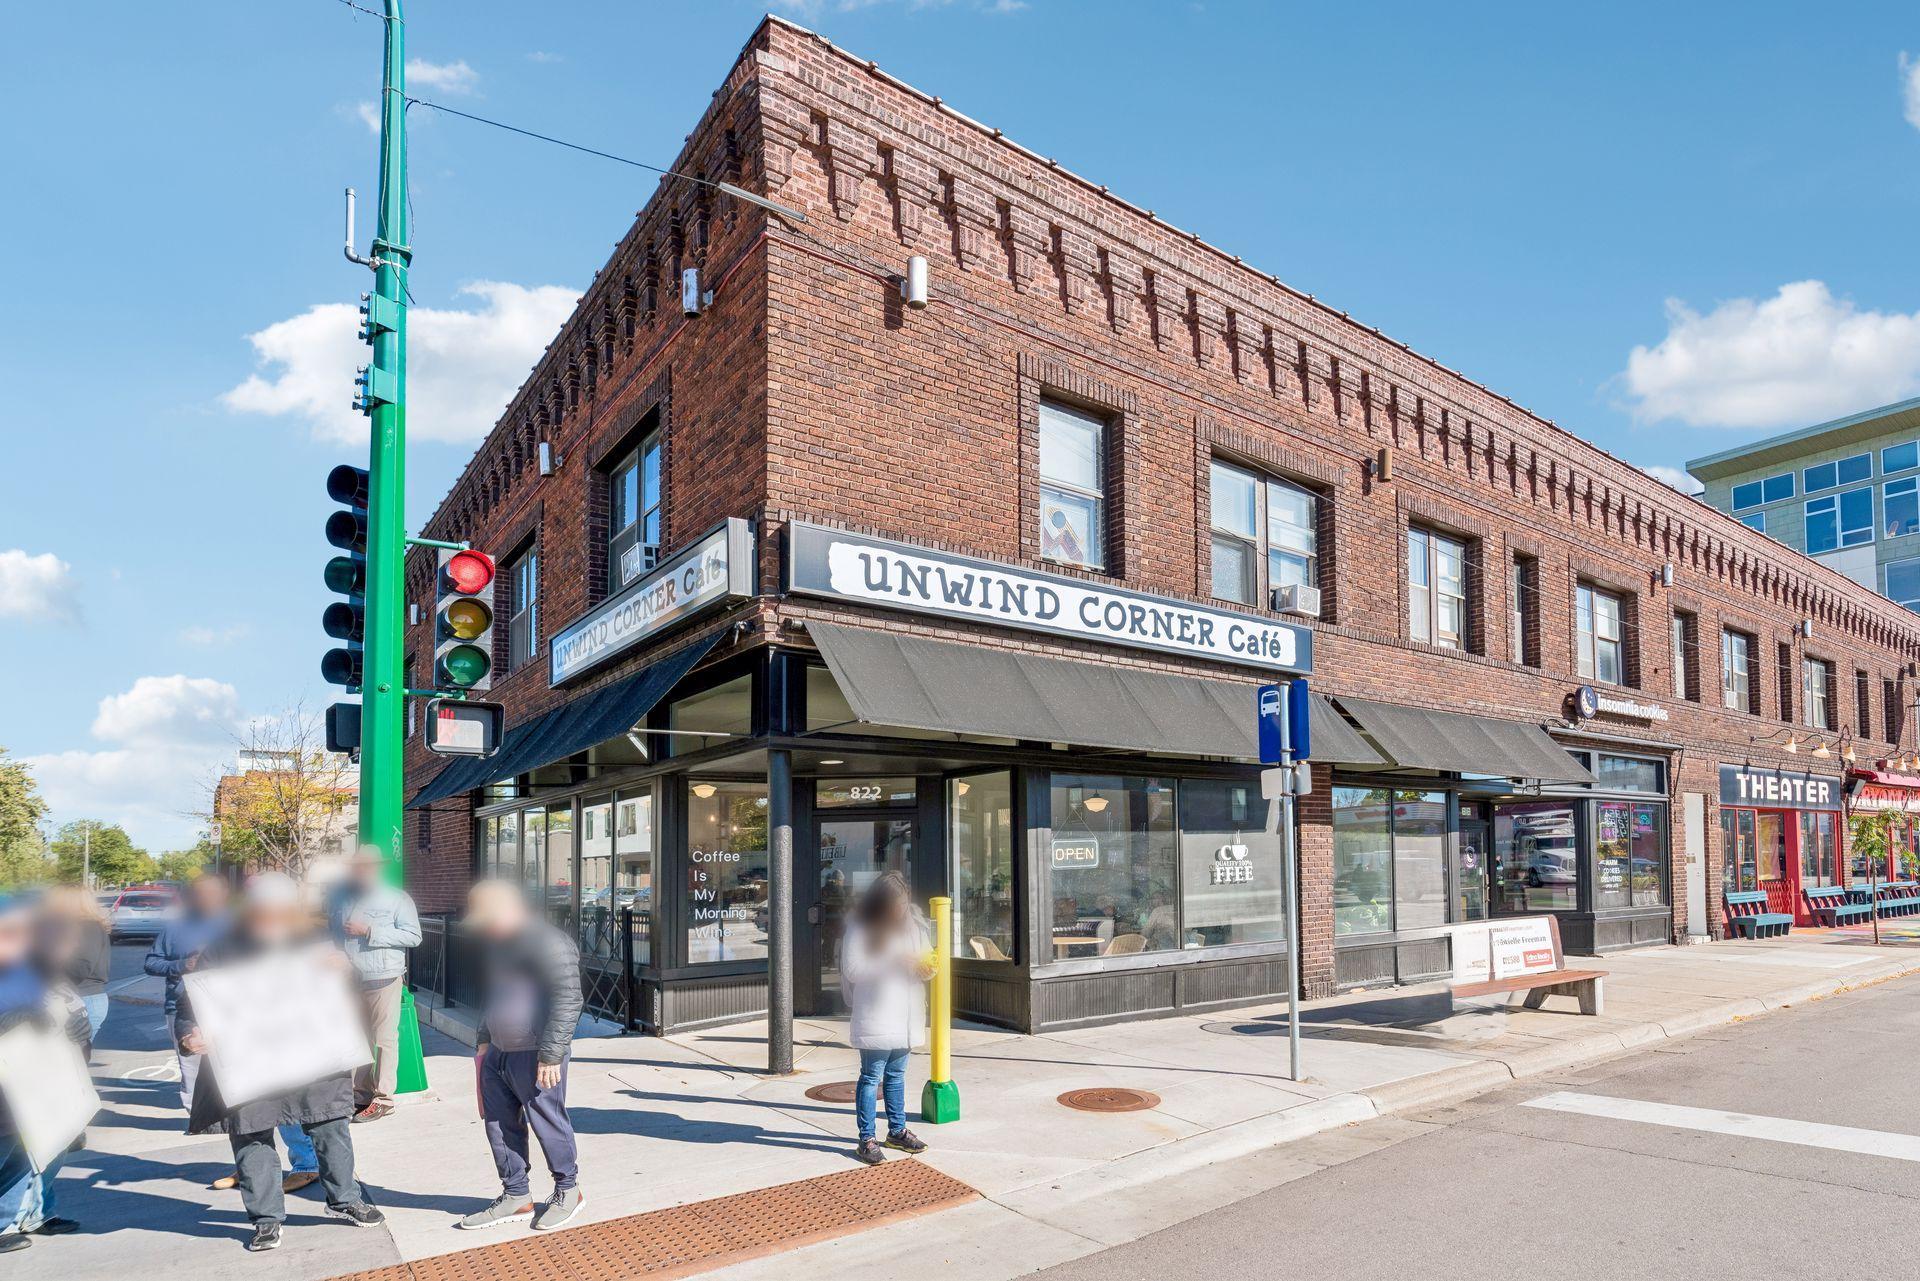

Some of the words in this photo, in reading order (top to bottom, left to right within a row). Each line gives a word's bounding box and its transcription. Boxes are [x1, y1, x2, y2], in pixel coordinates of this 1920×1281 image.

[554, 622, 609, 669] UNWIND
[613, 578, 677, 636] CORNER
[683, 550, 721, 596] Café
[858, 551, 1061, 620] UNWIND
[1078, 595, 1216, 649] CORNER
[1227, 624, 1282, 659] Café
[850, 786, 882, 800] 822
[1736, 772, 1830, 804] THEATER
[692, 850, 740, 863] Coffee
[1055, 847, 1095, 861] OPEN
[694, 869, 707, 882] Is
[694, 888, 716, 902] My
[694, 908, 747, 920] Morning
[695, 927, 735, 938] Wine.
